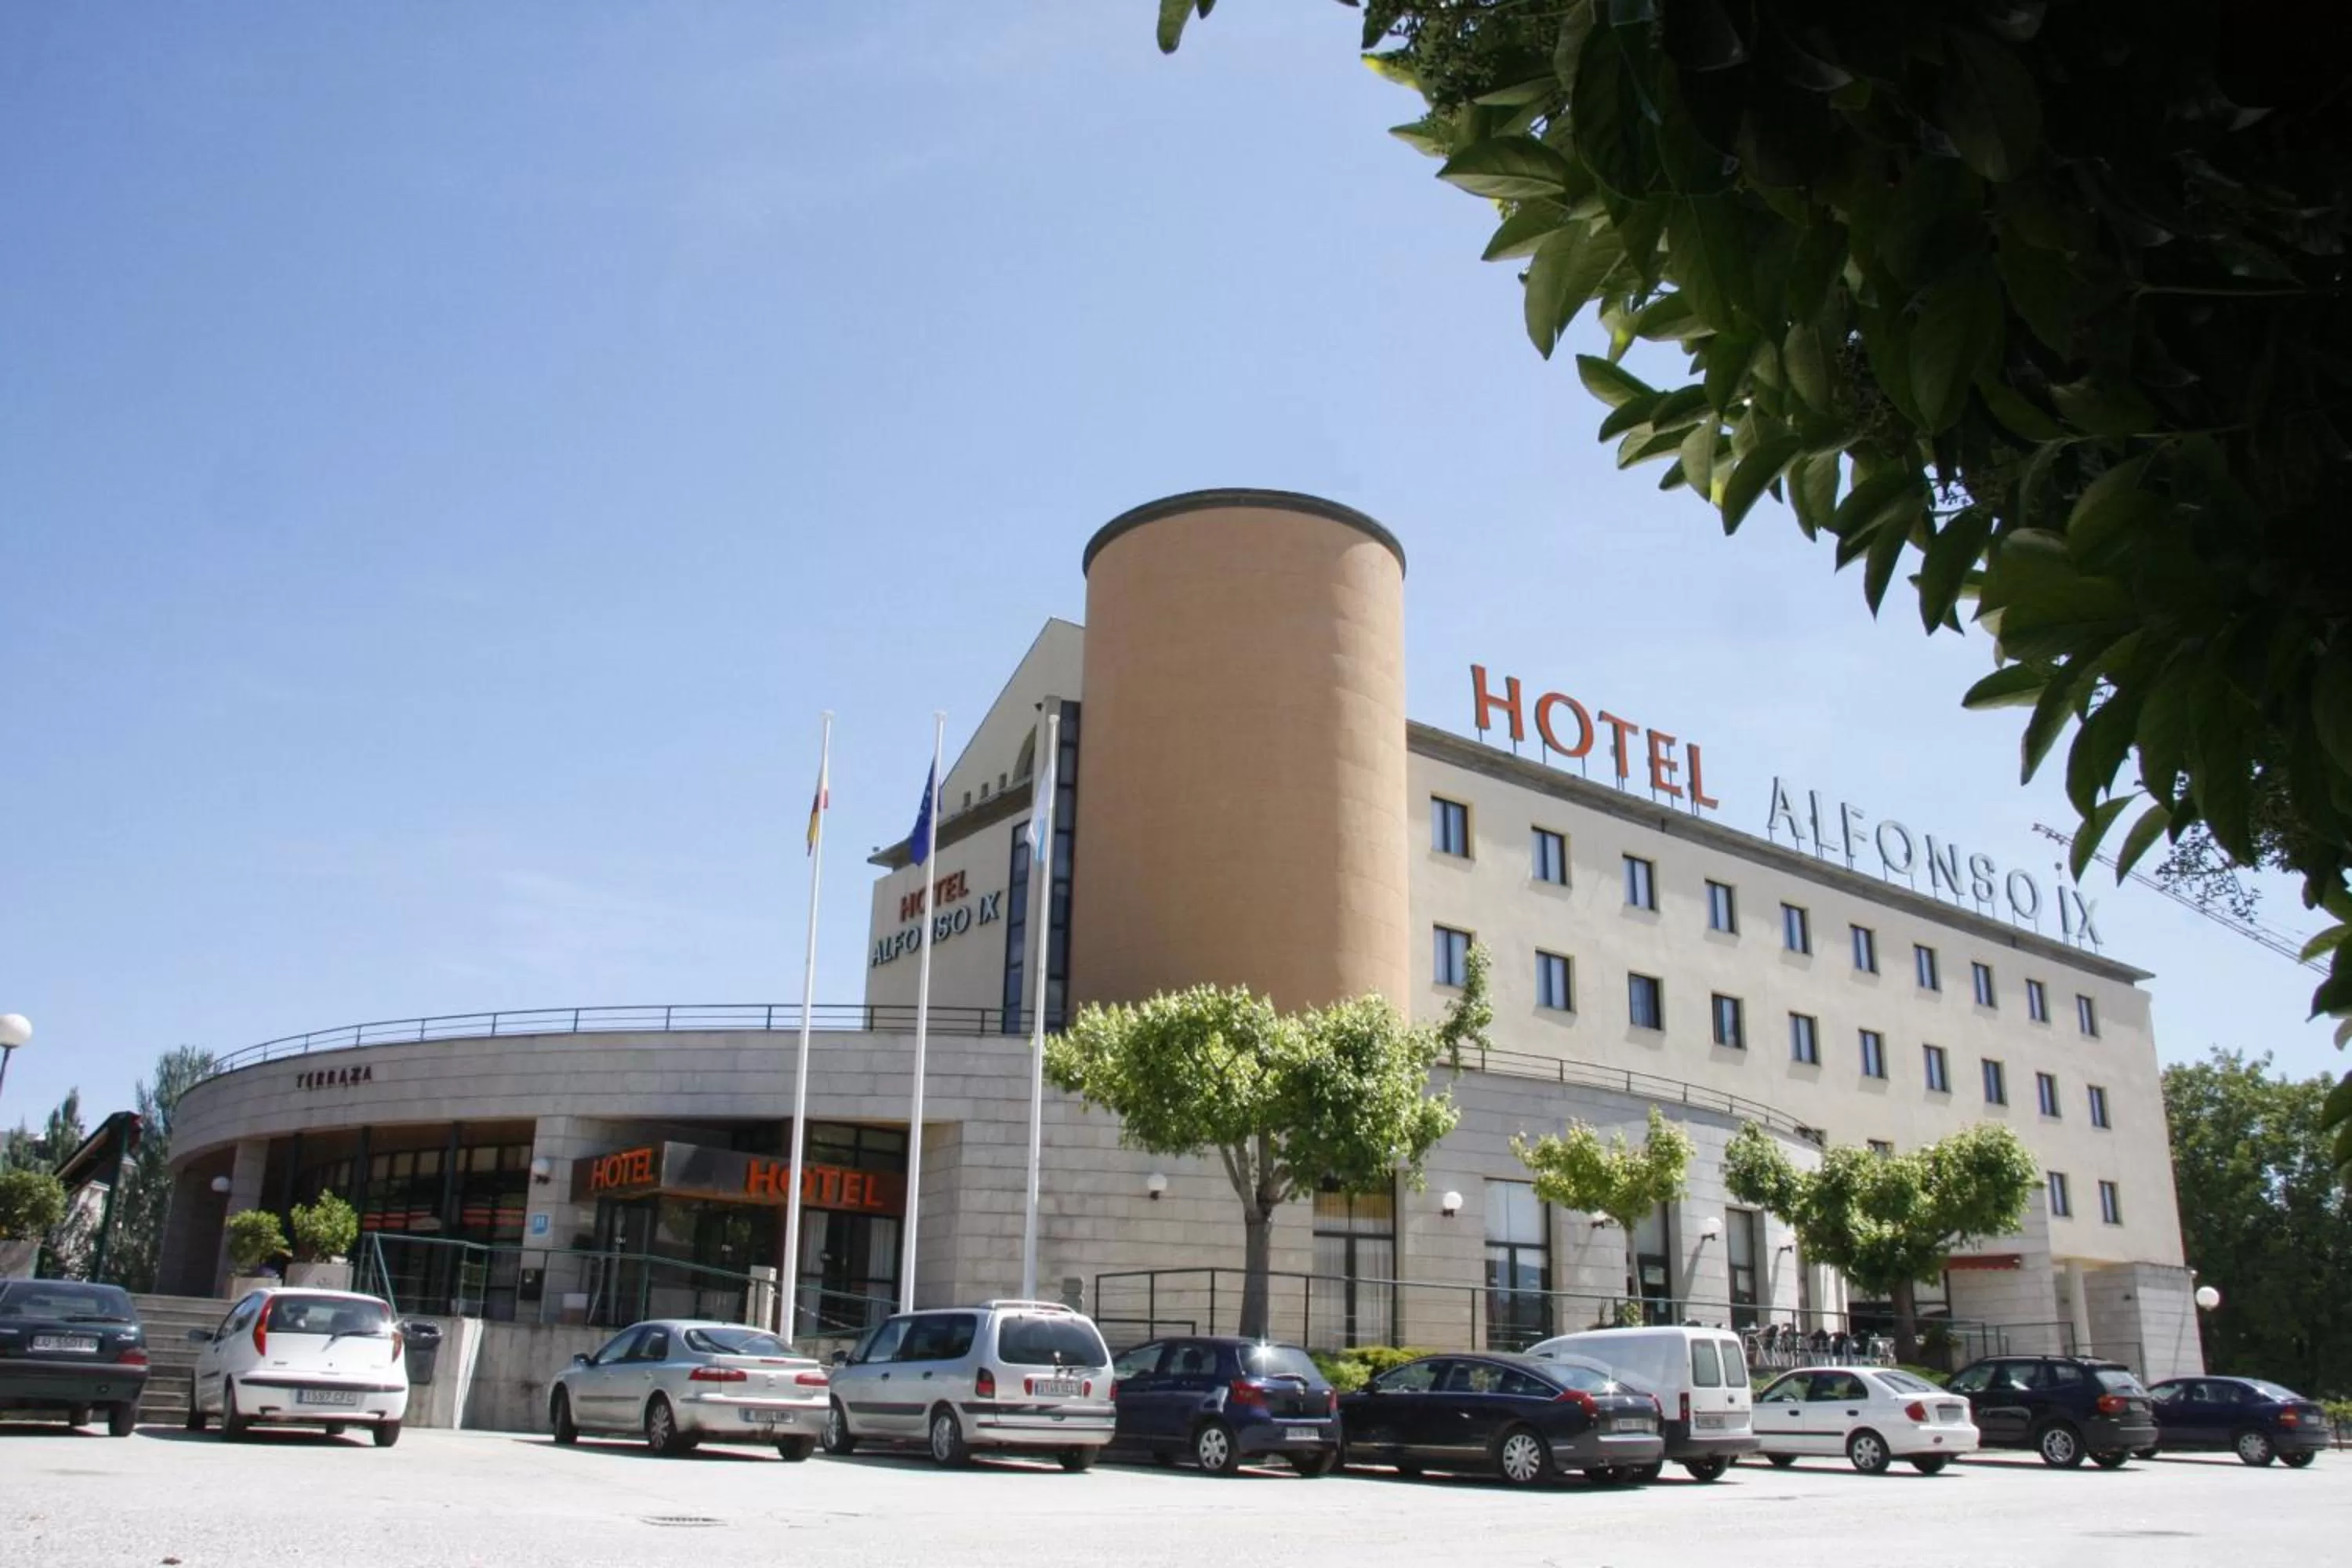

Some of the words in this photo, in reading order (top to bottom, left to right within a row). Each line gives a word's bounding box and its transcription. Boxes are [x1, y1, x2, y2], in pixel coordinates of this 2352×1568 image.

[1471, 664, 1719, 810] HOTEL
[1766, 776, 2042, 919] ALFONSO
[978, 891, 1001, 925] IX
[296, 1065, 372, 1091] TERRAZA
[590, 1148, 653, 1191] HOTEL
[748, 1159, 884, 1207] HOTEL
